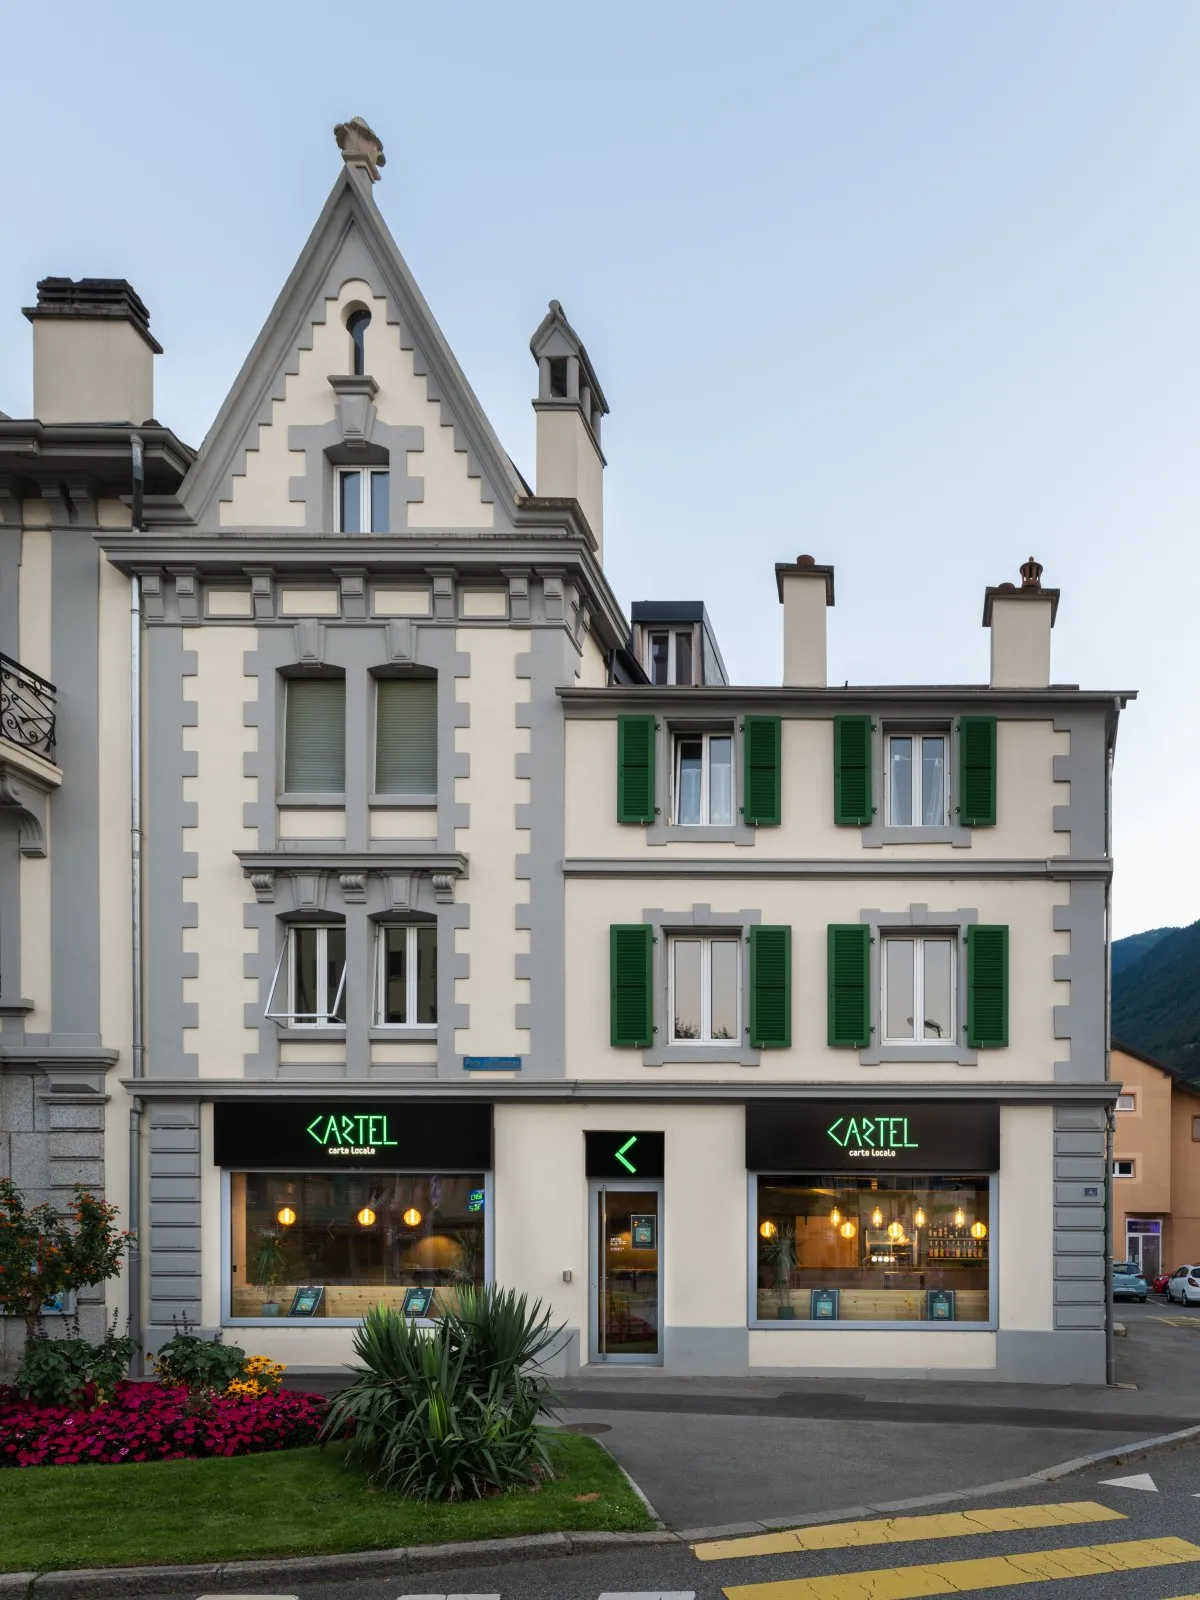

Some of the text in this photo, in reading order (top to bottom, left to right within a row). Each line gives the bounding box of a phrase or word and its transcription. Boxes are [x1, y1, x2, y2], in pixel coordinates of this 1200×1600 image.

[306, 1115, 399, 1145] CARTEL
[826, 1117, 919, 1147] CARTEL
[328, 1146, 376, 1155] carte locale
[848, 1148, 897, 1157] carte locale
